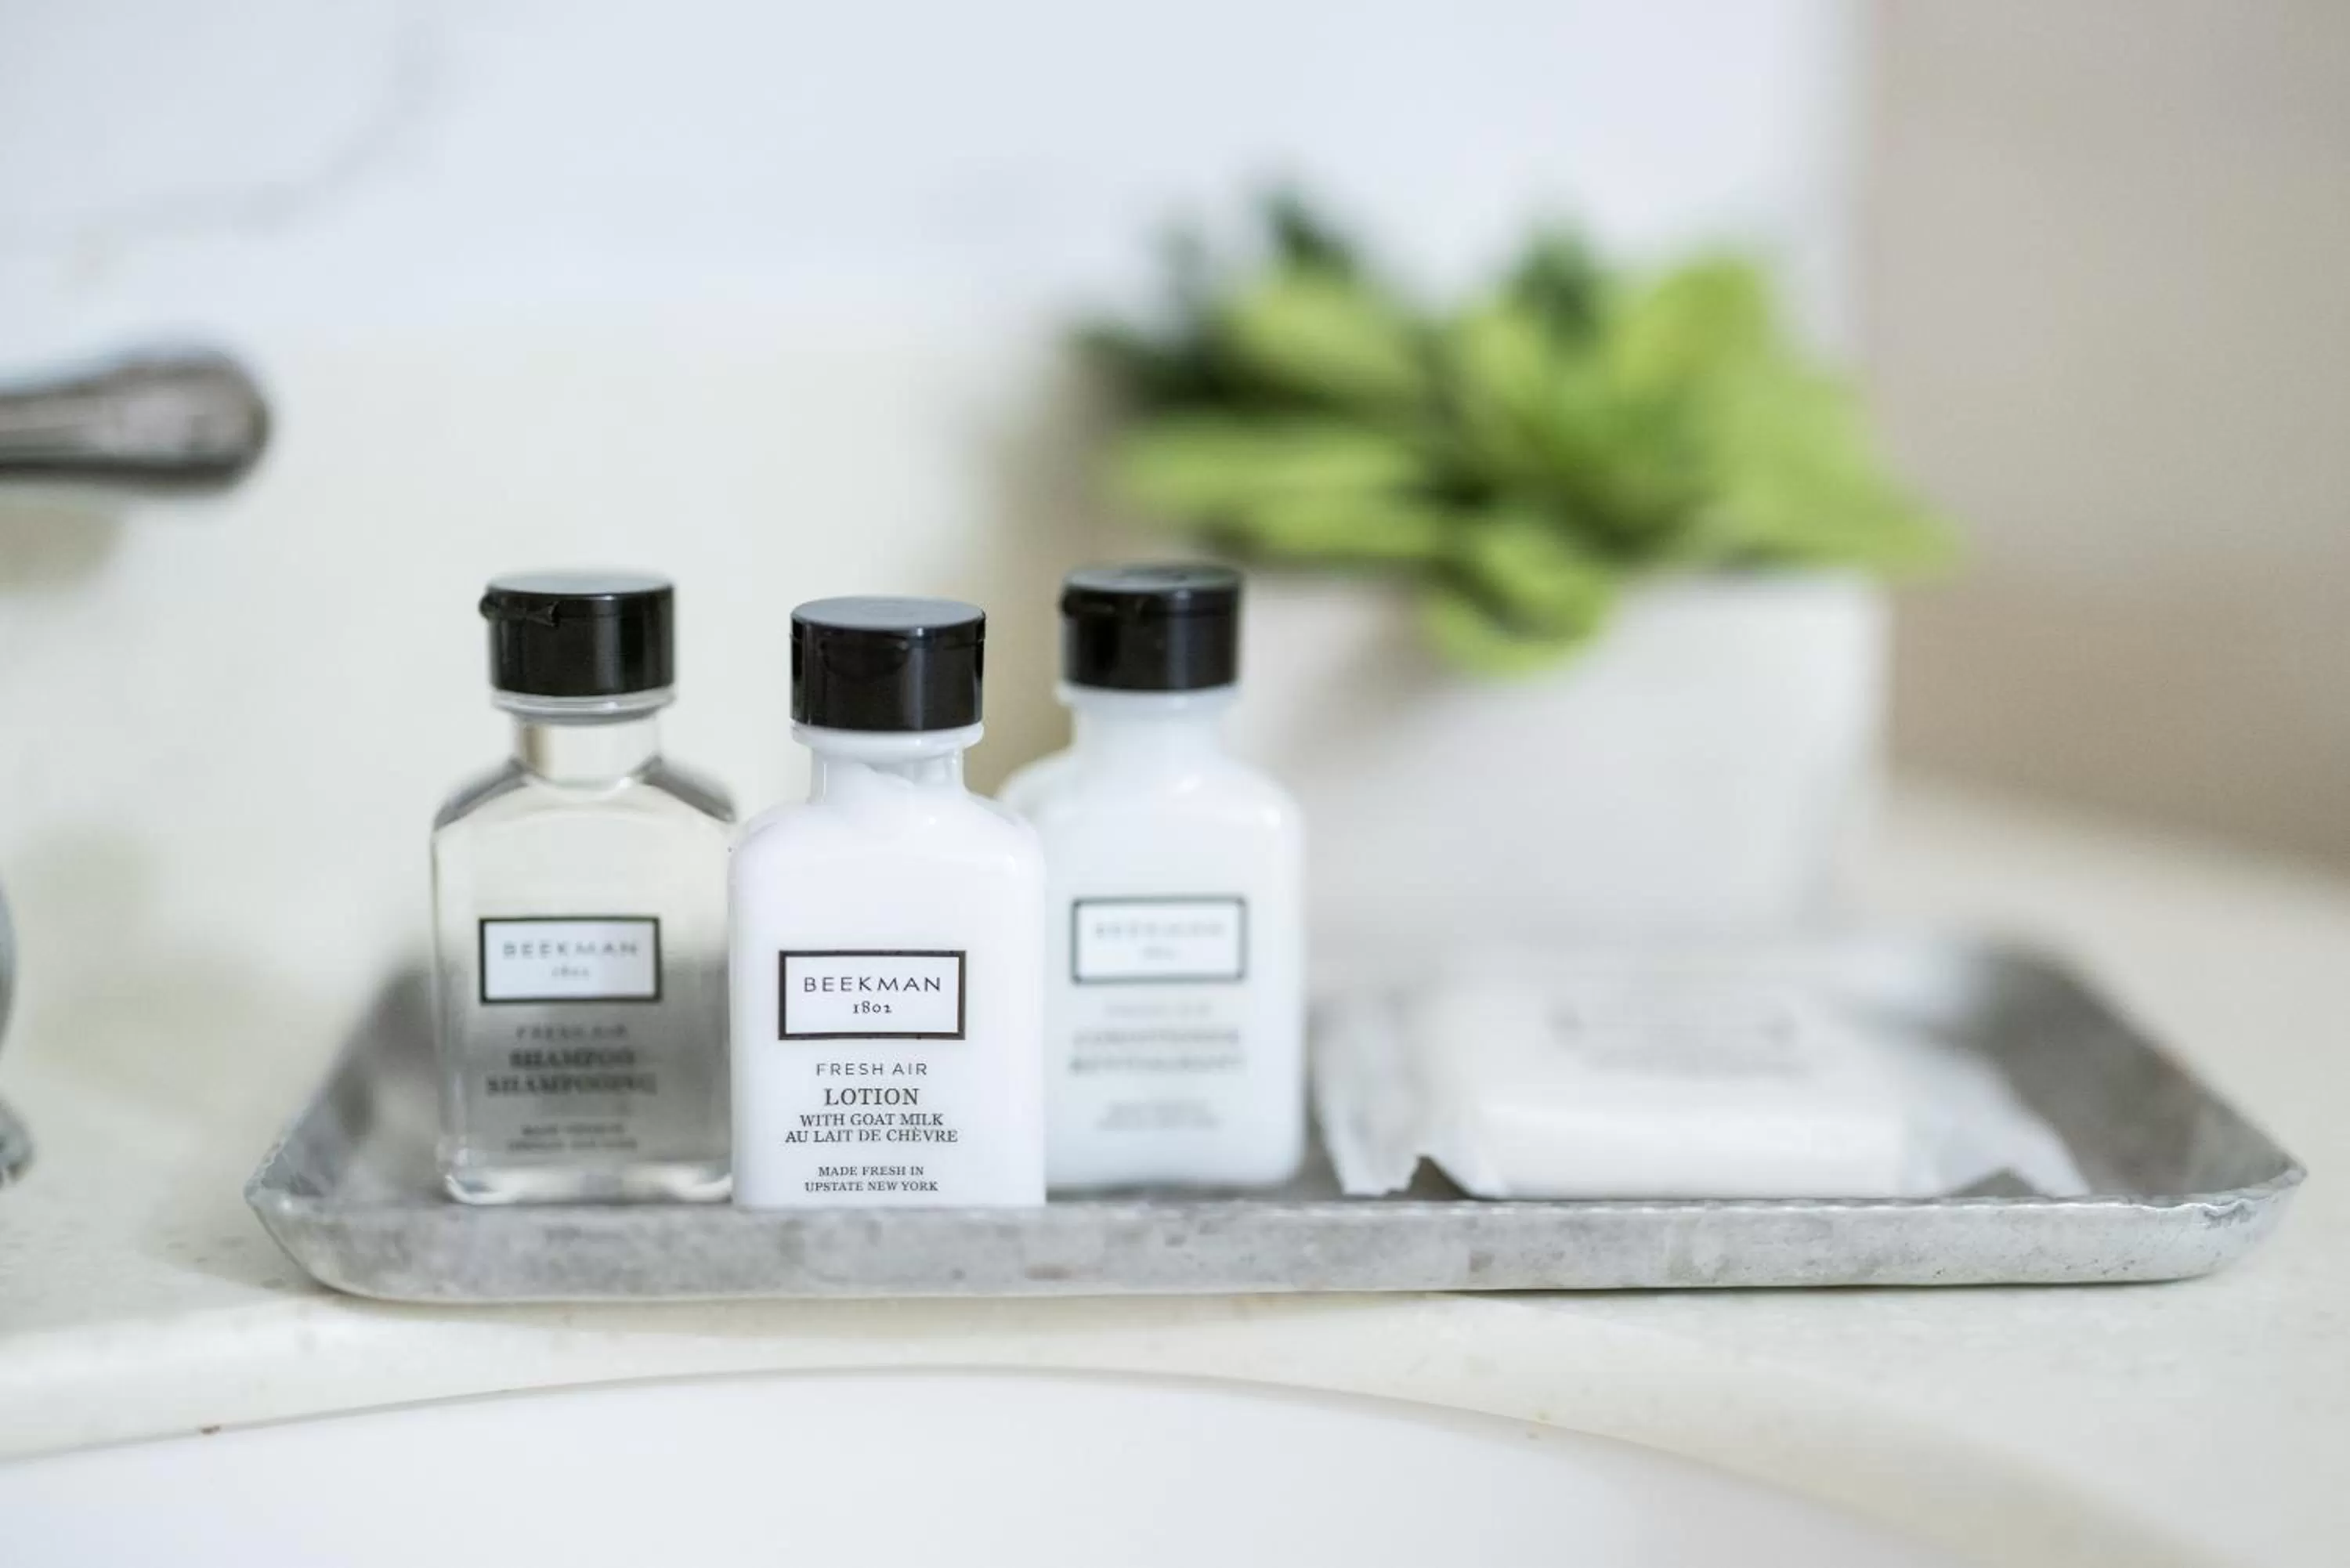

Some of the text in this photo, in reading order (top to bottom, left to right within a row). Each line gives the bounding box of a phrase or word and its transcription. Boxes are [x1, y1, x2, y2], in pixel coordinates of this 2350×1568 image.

[804, 977, 942, 992] BEEKMAN
[853, 1000, 892, 1014] 1802
[816, 1063, 927, 1076] FRESH AIR
[824, 1088, 920, 1106] LOTION
[800, 1113, 943, 1126] WITH GOAT MILK
[785, 1126, 958, 1143] AU LAIT DE CHÈVRE
[818, 1165, 924, 1176] MADE FRESH IN
[805, 1180, 938, 1192] UPSTATE NEW YORK
